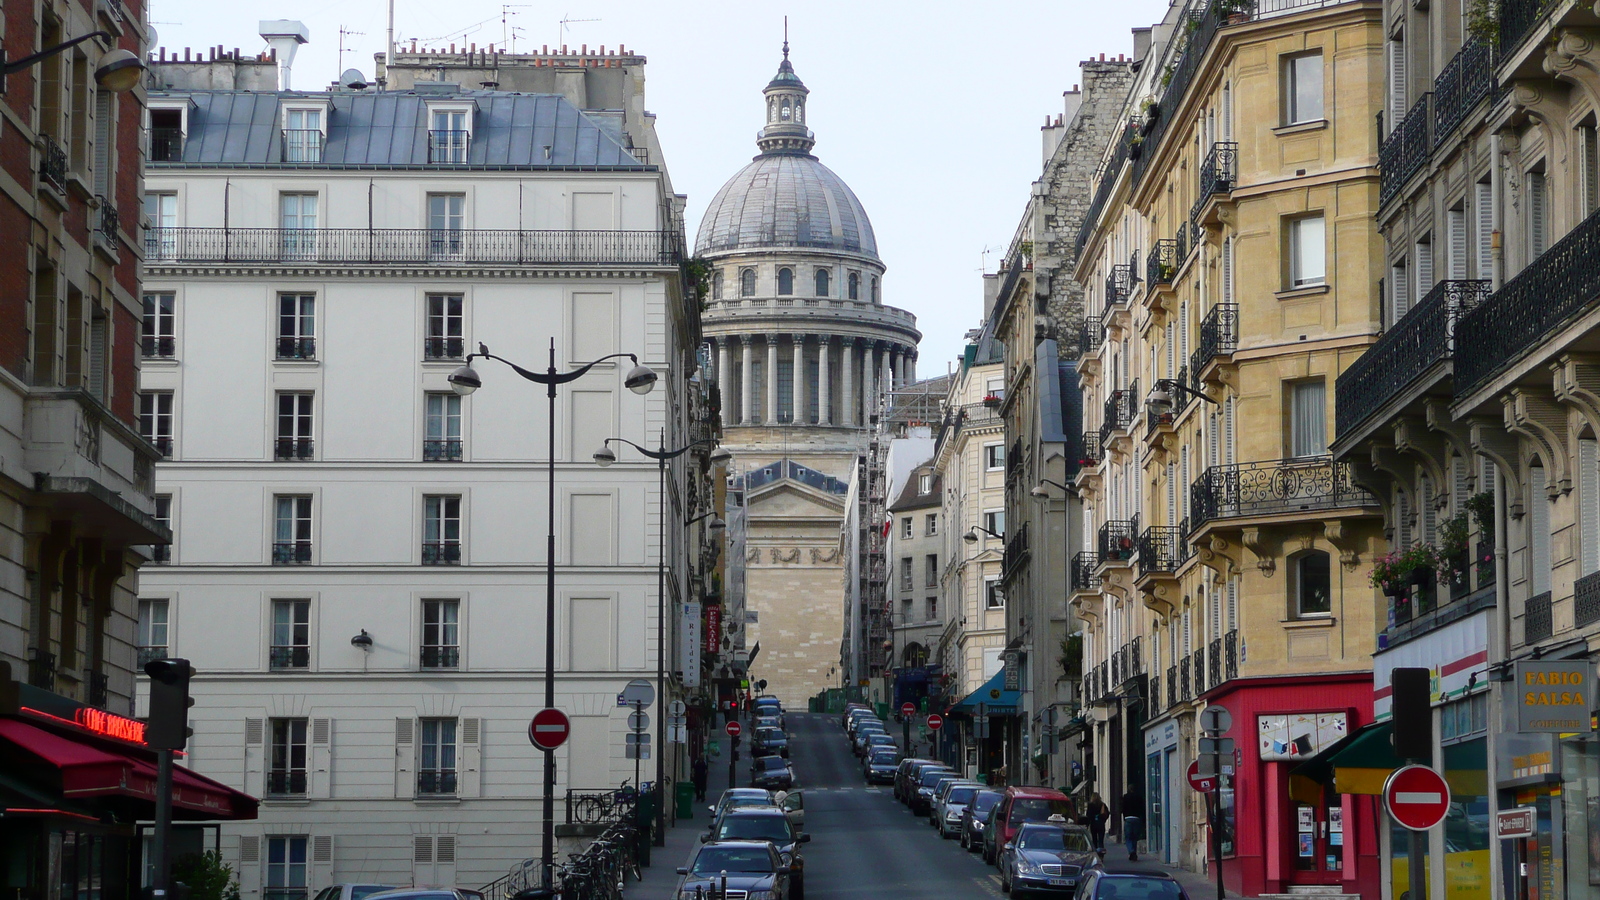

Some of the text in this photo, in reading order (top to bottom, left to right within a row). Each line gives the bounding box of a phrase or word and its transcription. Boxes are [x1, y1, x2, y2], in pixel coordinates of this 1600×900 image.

[1005, 653, 1018, 689] GALERIE
[1525, 672, 1583, 685] FABIO
[1525, 691, 1585, 706] SALSA
[1529, 720, 1580, 728] COIFFURE
